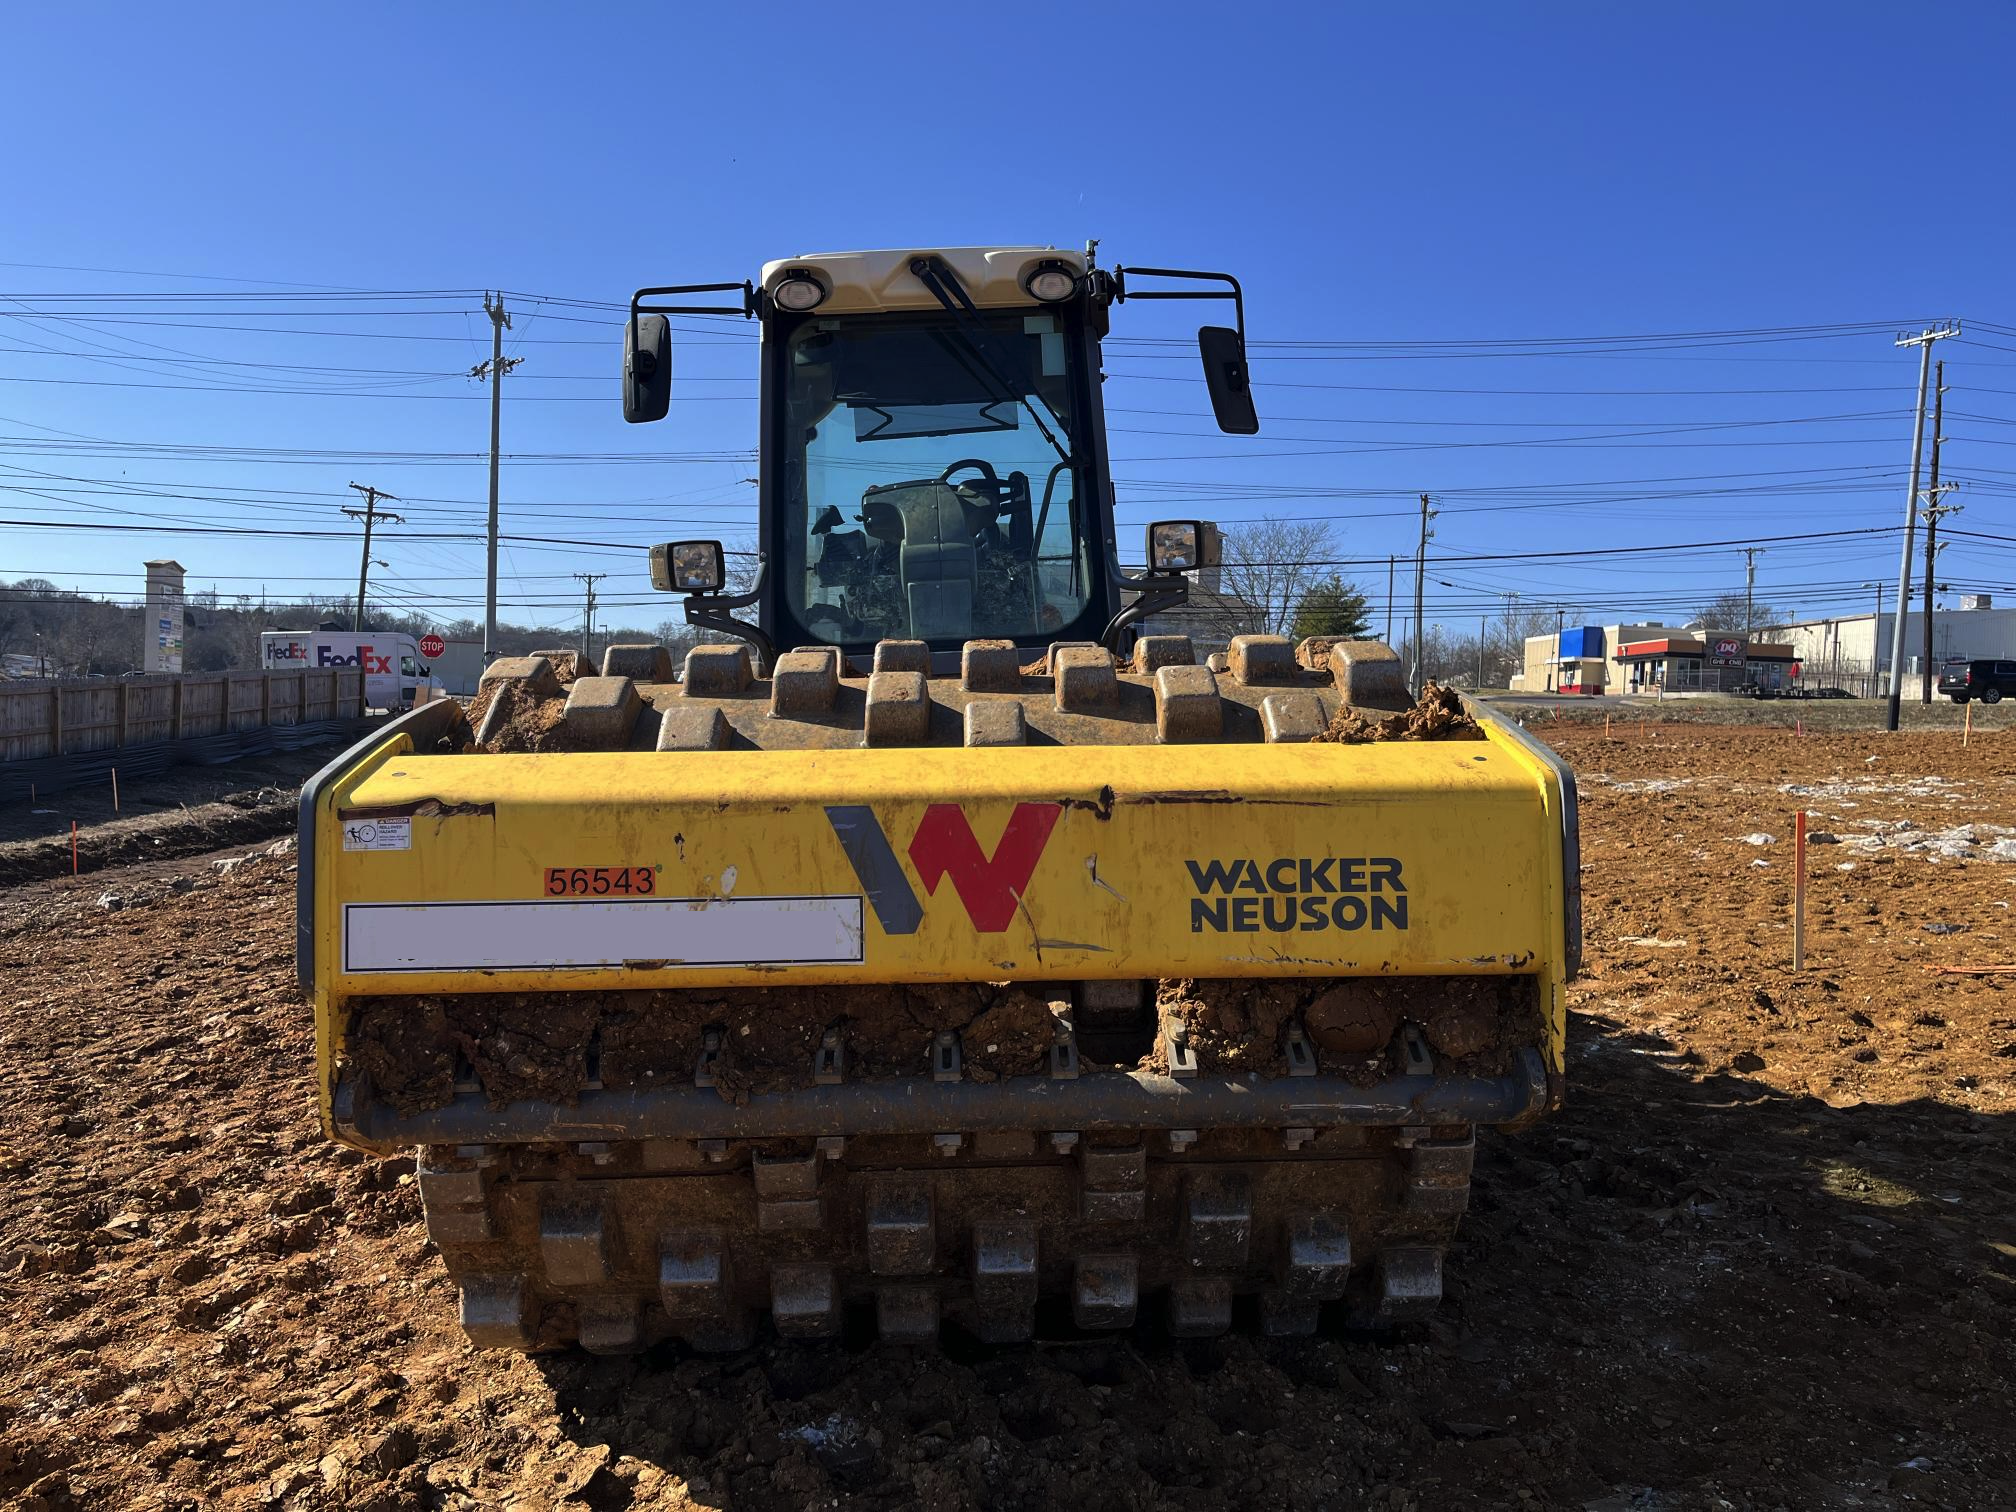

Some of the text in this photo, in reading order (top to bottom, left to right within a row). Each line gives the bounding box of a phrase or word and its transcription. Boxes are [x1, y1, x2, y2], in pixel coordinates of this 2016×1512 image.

[267, 642, 307, 660] FedEx
[317, 646, 392, 674] FedEx
[421, 641, 444, 652] STOP
[1720, 643, 1737, 652] DQ
[549, 868, 653, 895] 56543
[1185, 857, 1408, 894] WACKER
[1191, 895, 1409, 933] NEUSON
